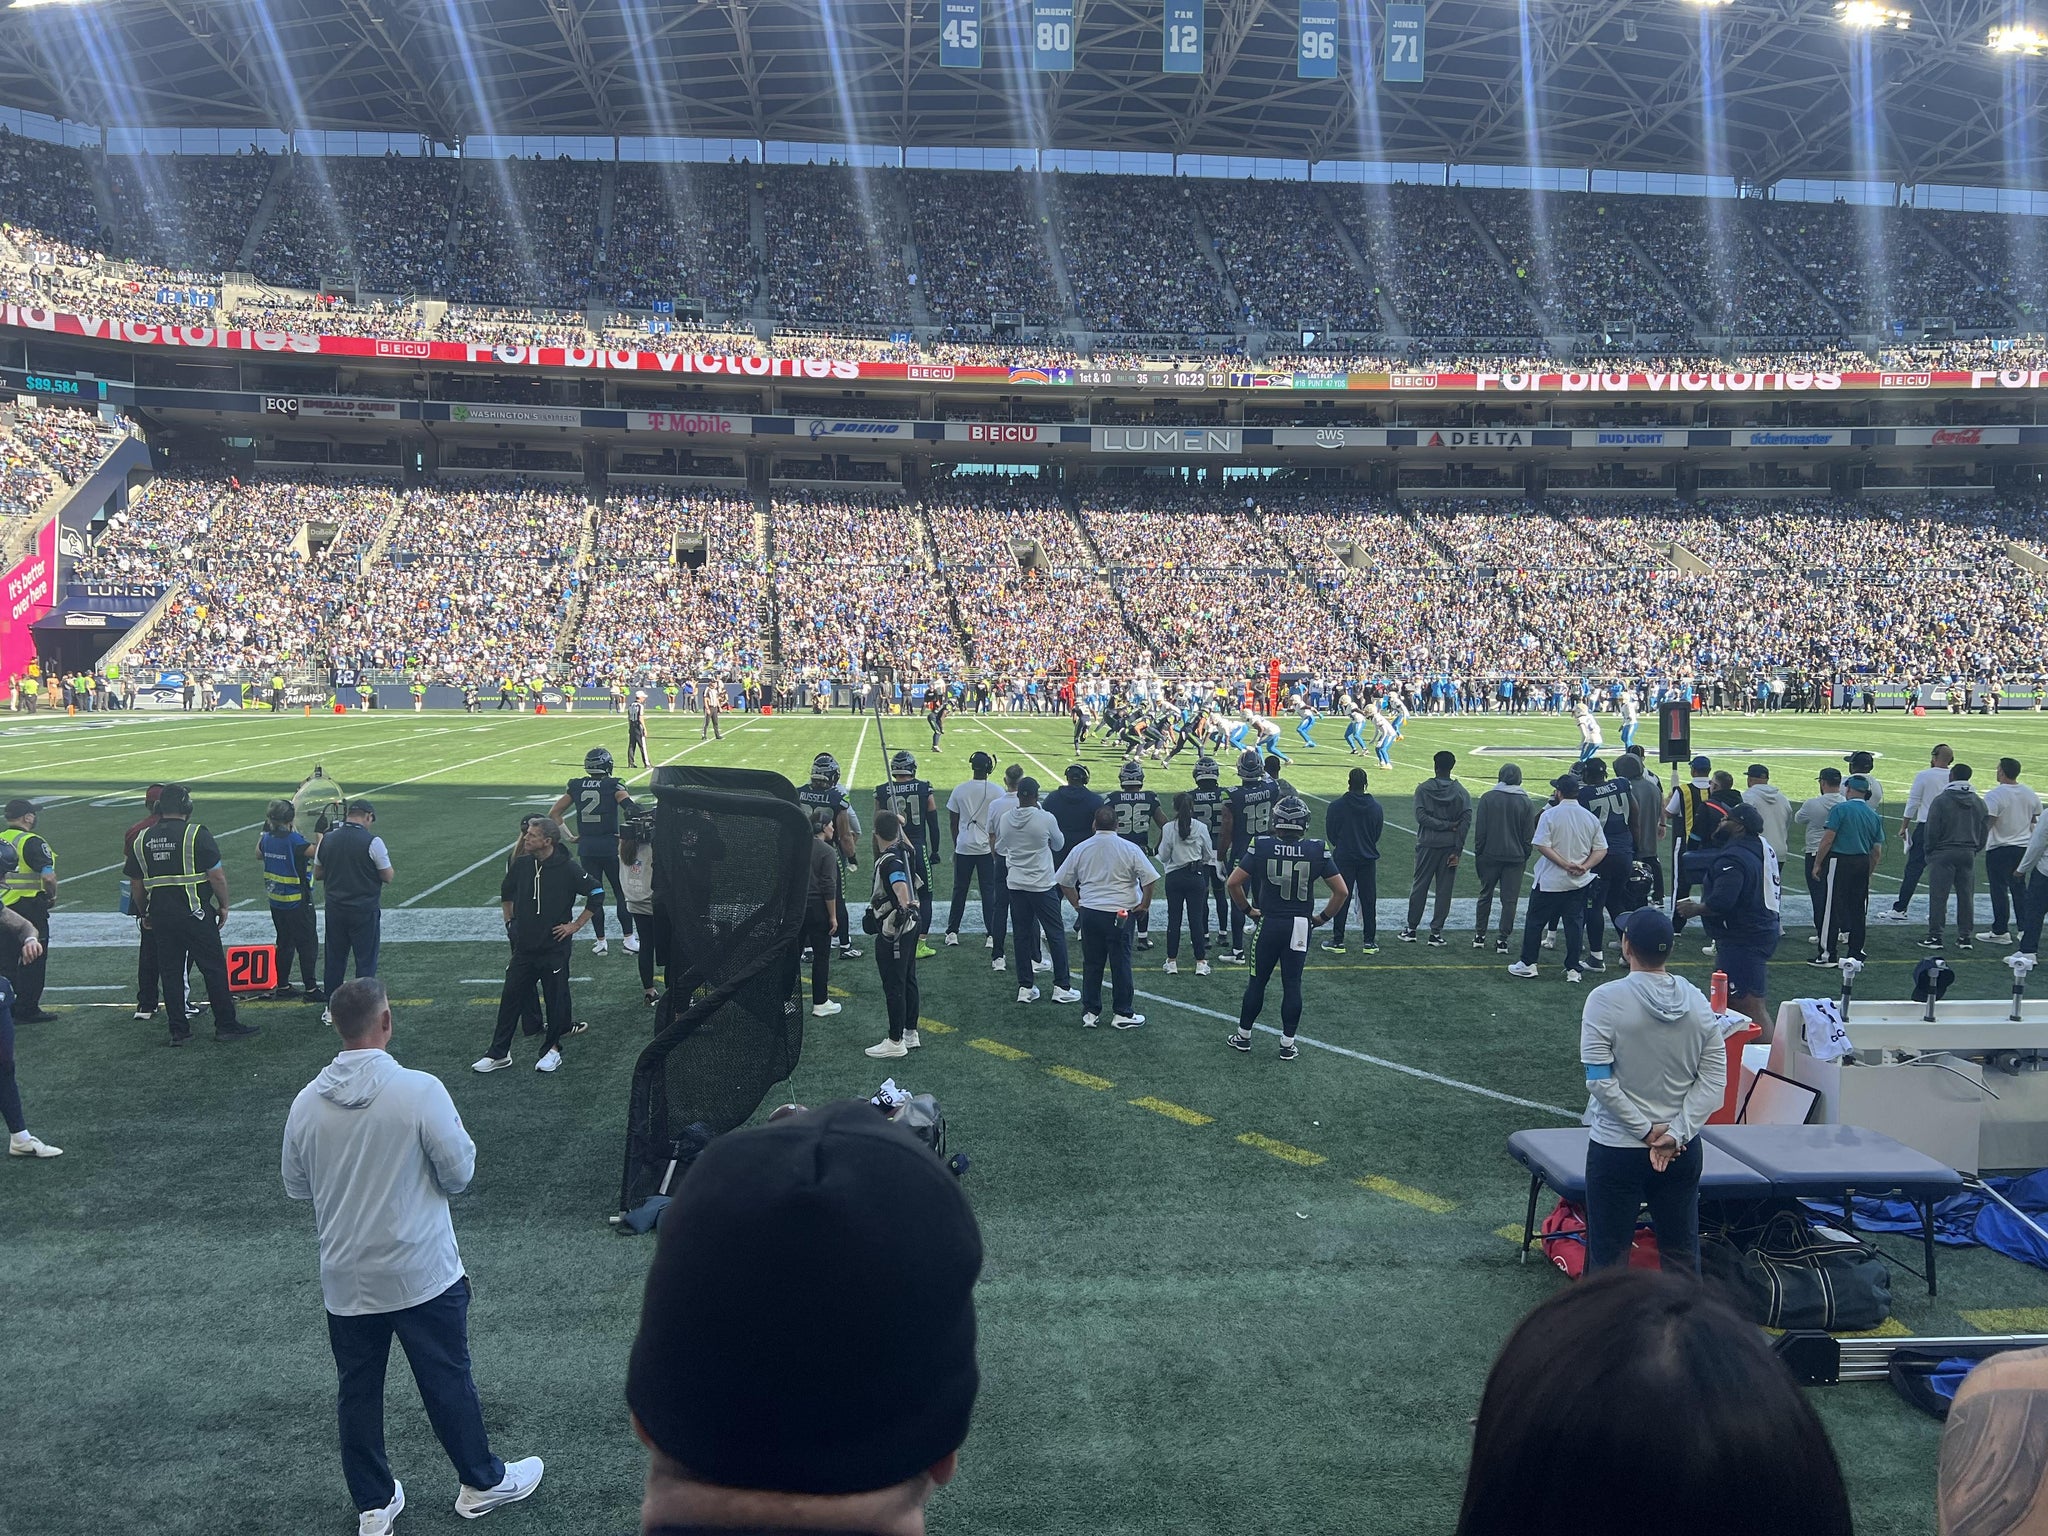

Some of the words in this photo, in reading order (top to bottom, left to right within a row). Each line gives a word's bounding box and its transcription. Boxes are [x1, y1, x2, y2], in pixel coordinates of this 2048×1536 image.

[1035, 8, 1072, 16] LARGENT
[1302, 17, 1336, 25] KENNEDY
[1393, 21, 1418, 29] JONES
[943, 20, 977, 48] 45
[1037, 23, 1070, 51] 80
[1169, 25, 1197, 53] 12
[1302, 32, 1334, 59] 96
[1391, 35, 1418, 62] 71
[34, 250, 52, 265] 12
[162, 291, 177, 303] 12
[195, 295, 209, 308] 12
[657, 301, 670, 313] 12
[0, 303, 56, 332] ig
[380, 343, 427, 355] BECU
[1998, 340, 2010, 350] 12
[911, 369, 952, 379] BECU
[1058, 370, 1067, 384] 3
[1079, 373, 1093, 383] 1st
[1101, 373, 1111, 383] 10
[1137, 374, 1148, 384] 35
[1162, 374, 1169, 384] 2
[1174, 373, 1205, 386] 10:23
[1211, 374, 1223, 386] 12
[1236, 374, 1244, 386] 7
[26, 375, 79, 394] $89,584
[1393, 377, 1434, 387] BECU
[1884, 376, 1927, 386] BECU
[266, 398, 298, 413] EQC
[303, 400, 355, 411] EMERALD
[357, 403, 396, 412] QUEEN
[469, 409, 538, 421] WASHINGTON'S
[541, 413, 579, 423] LOTTERY
[670, 413, 731, 433] Mobile
[831, 422, 899, 433] BOEING
[972, 426, 1034, 440] BECU
[1316, 429, 1344, 440] aws
[1452, 432, 1522, 445] DELTA
[1599, 434, 1625, 444] BUD
[1626, 434, 1663, 445] LIGHT
[1749, 433, 1832, 445] ticketmaster
[1103, 429, 1231, 451] LUMEN
[8, 580, 23, 600] It's
[22, 560, 46, 589] better
[87, 585, 156, 597] LUMEN
[12, 597, 30, 620] over
[29, 580, 48, 604] here
[1670, 709, 1682, 740] 1
[582, 780, 601, 788] LOCK
[1595, 782, 1618, 796] JONES
[799, 791, 831, 804] RUSSELL
[1194, 792, 1216, 800] JONES
[1244, 789, 1271, 803] ARROYO
[580, 790, 601, 822] 2
[1589, 792, 1630, 830] 74
[1115, 803, 1151, 834] 36
[1243, 800, 1272, 835] 18
[1274, 844, 1304, 857] STOLL
[1267, 858, 1311, 901] 41
[230, 949, 269, 985] 20
